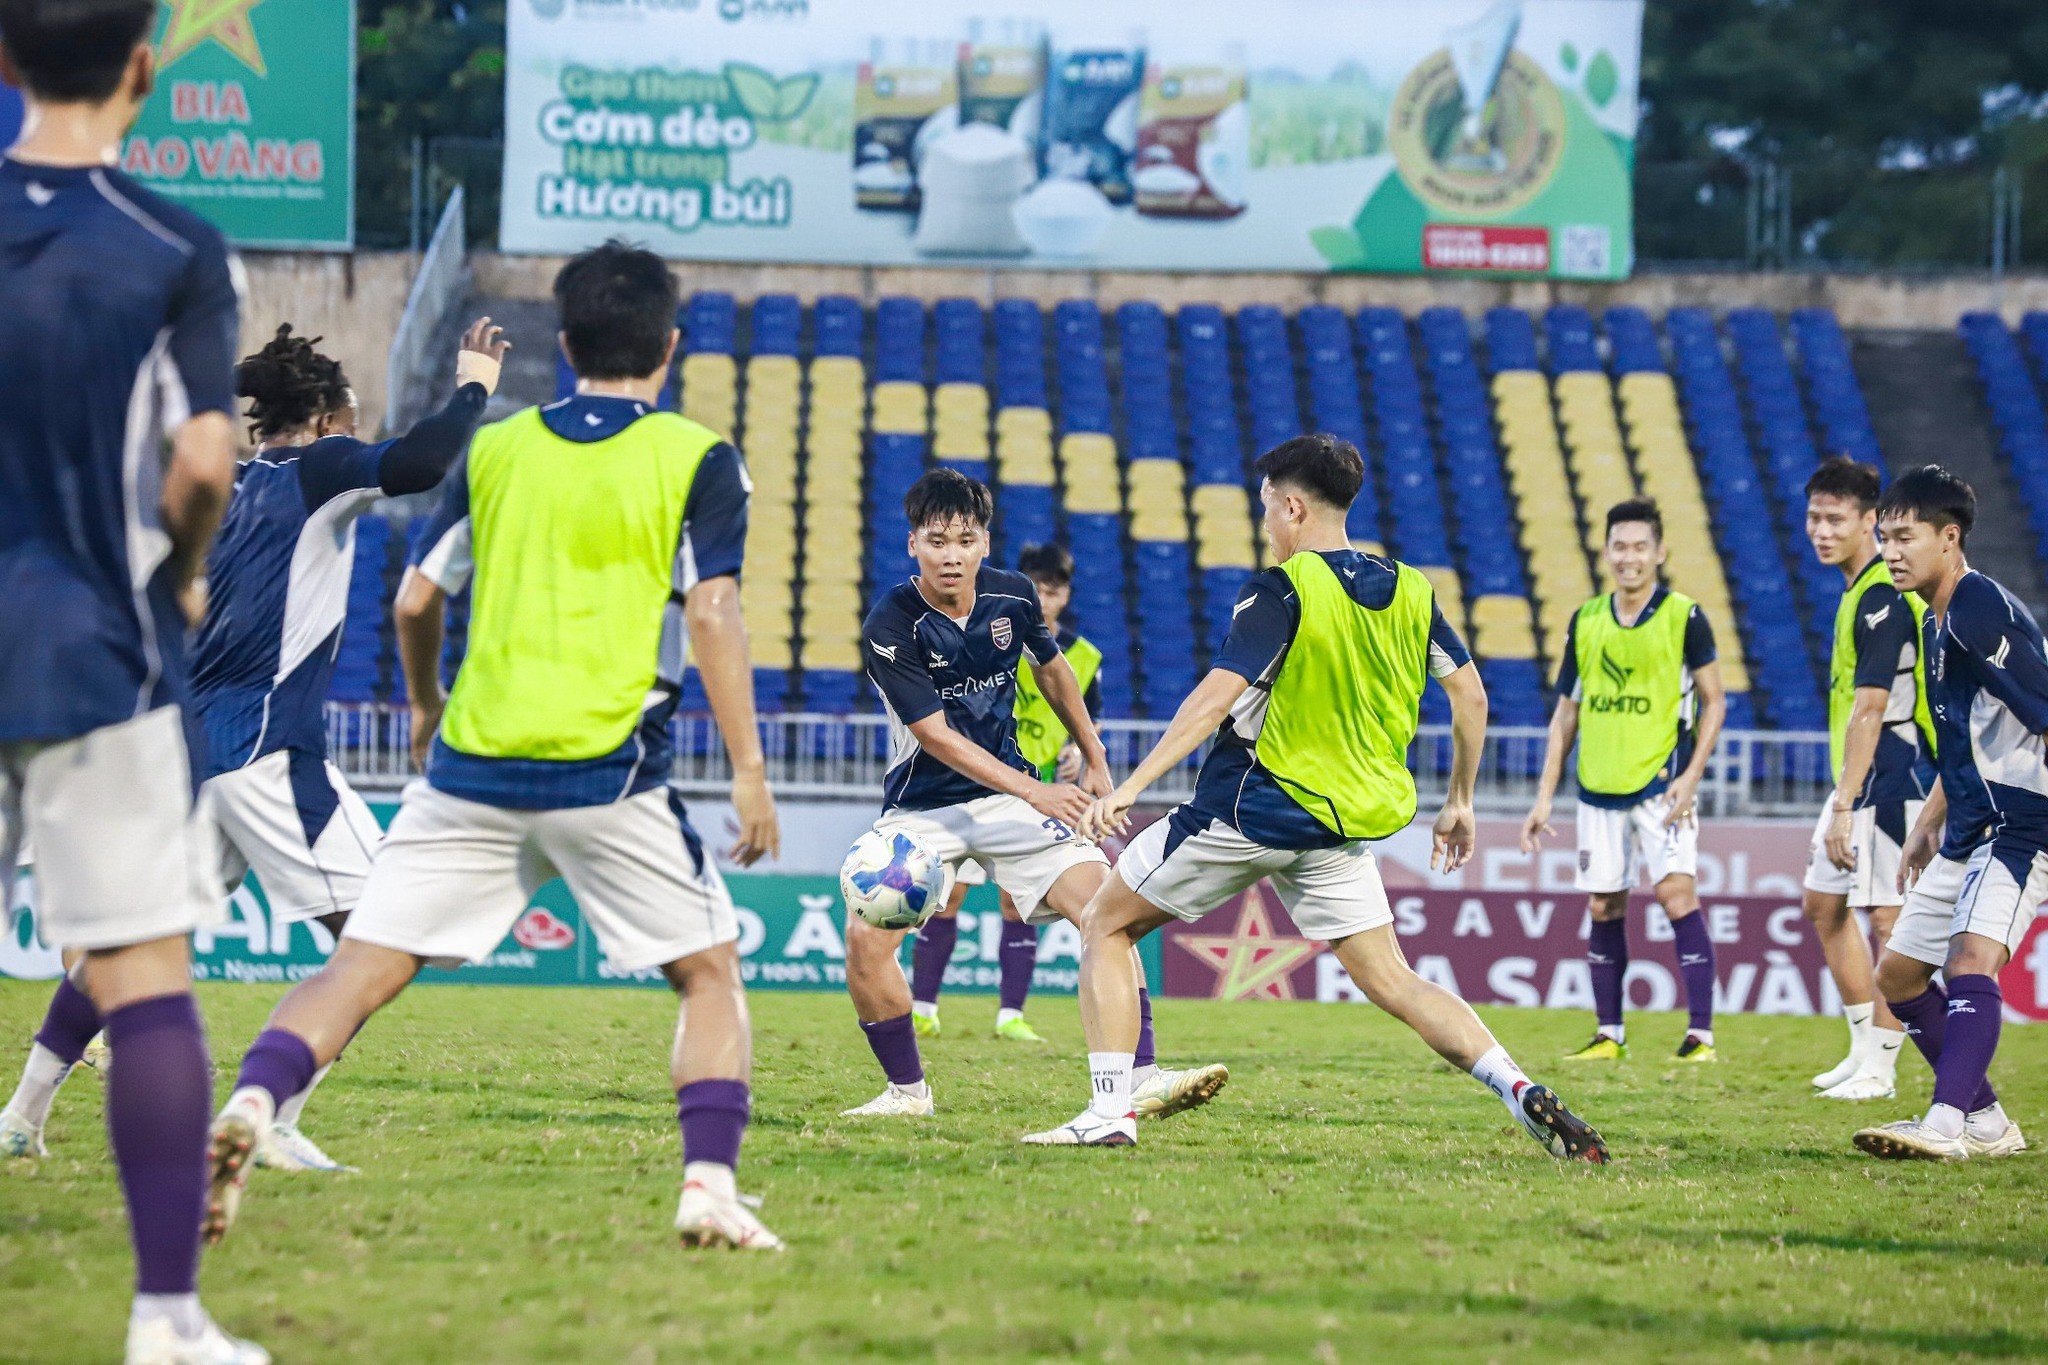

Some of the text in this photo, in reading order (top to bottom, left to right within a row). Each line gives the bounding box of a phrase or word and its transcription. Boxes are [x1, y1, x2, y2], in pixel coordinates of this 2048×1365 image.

[173, 80, 251, 123] BIA
[543, 103, 655, 143] Cơm
[120, 130, 323, 181] AO VÀNG
[542, 179, 702, 226] Hương
[225, 958, 285, 984] Ngon
[1094, 1077, 1113, 1093] 10
